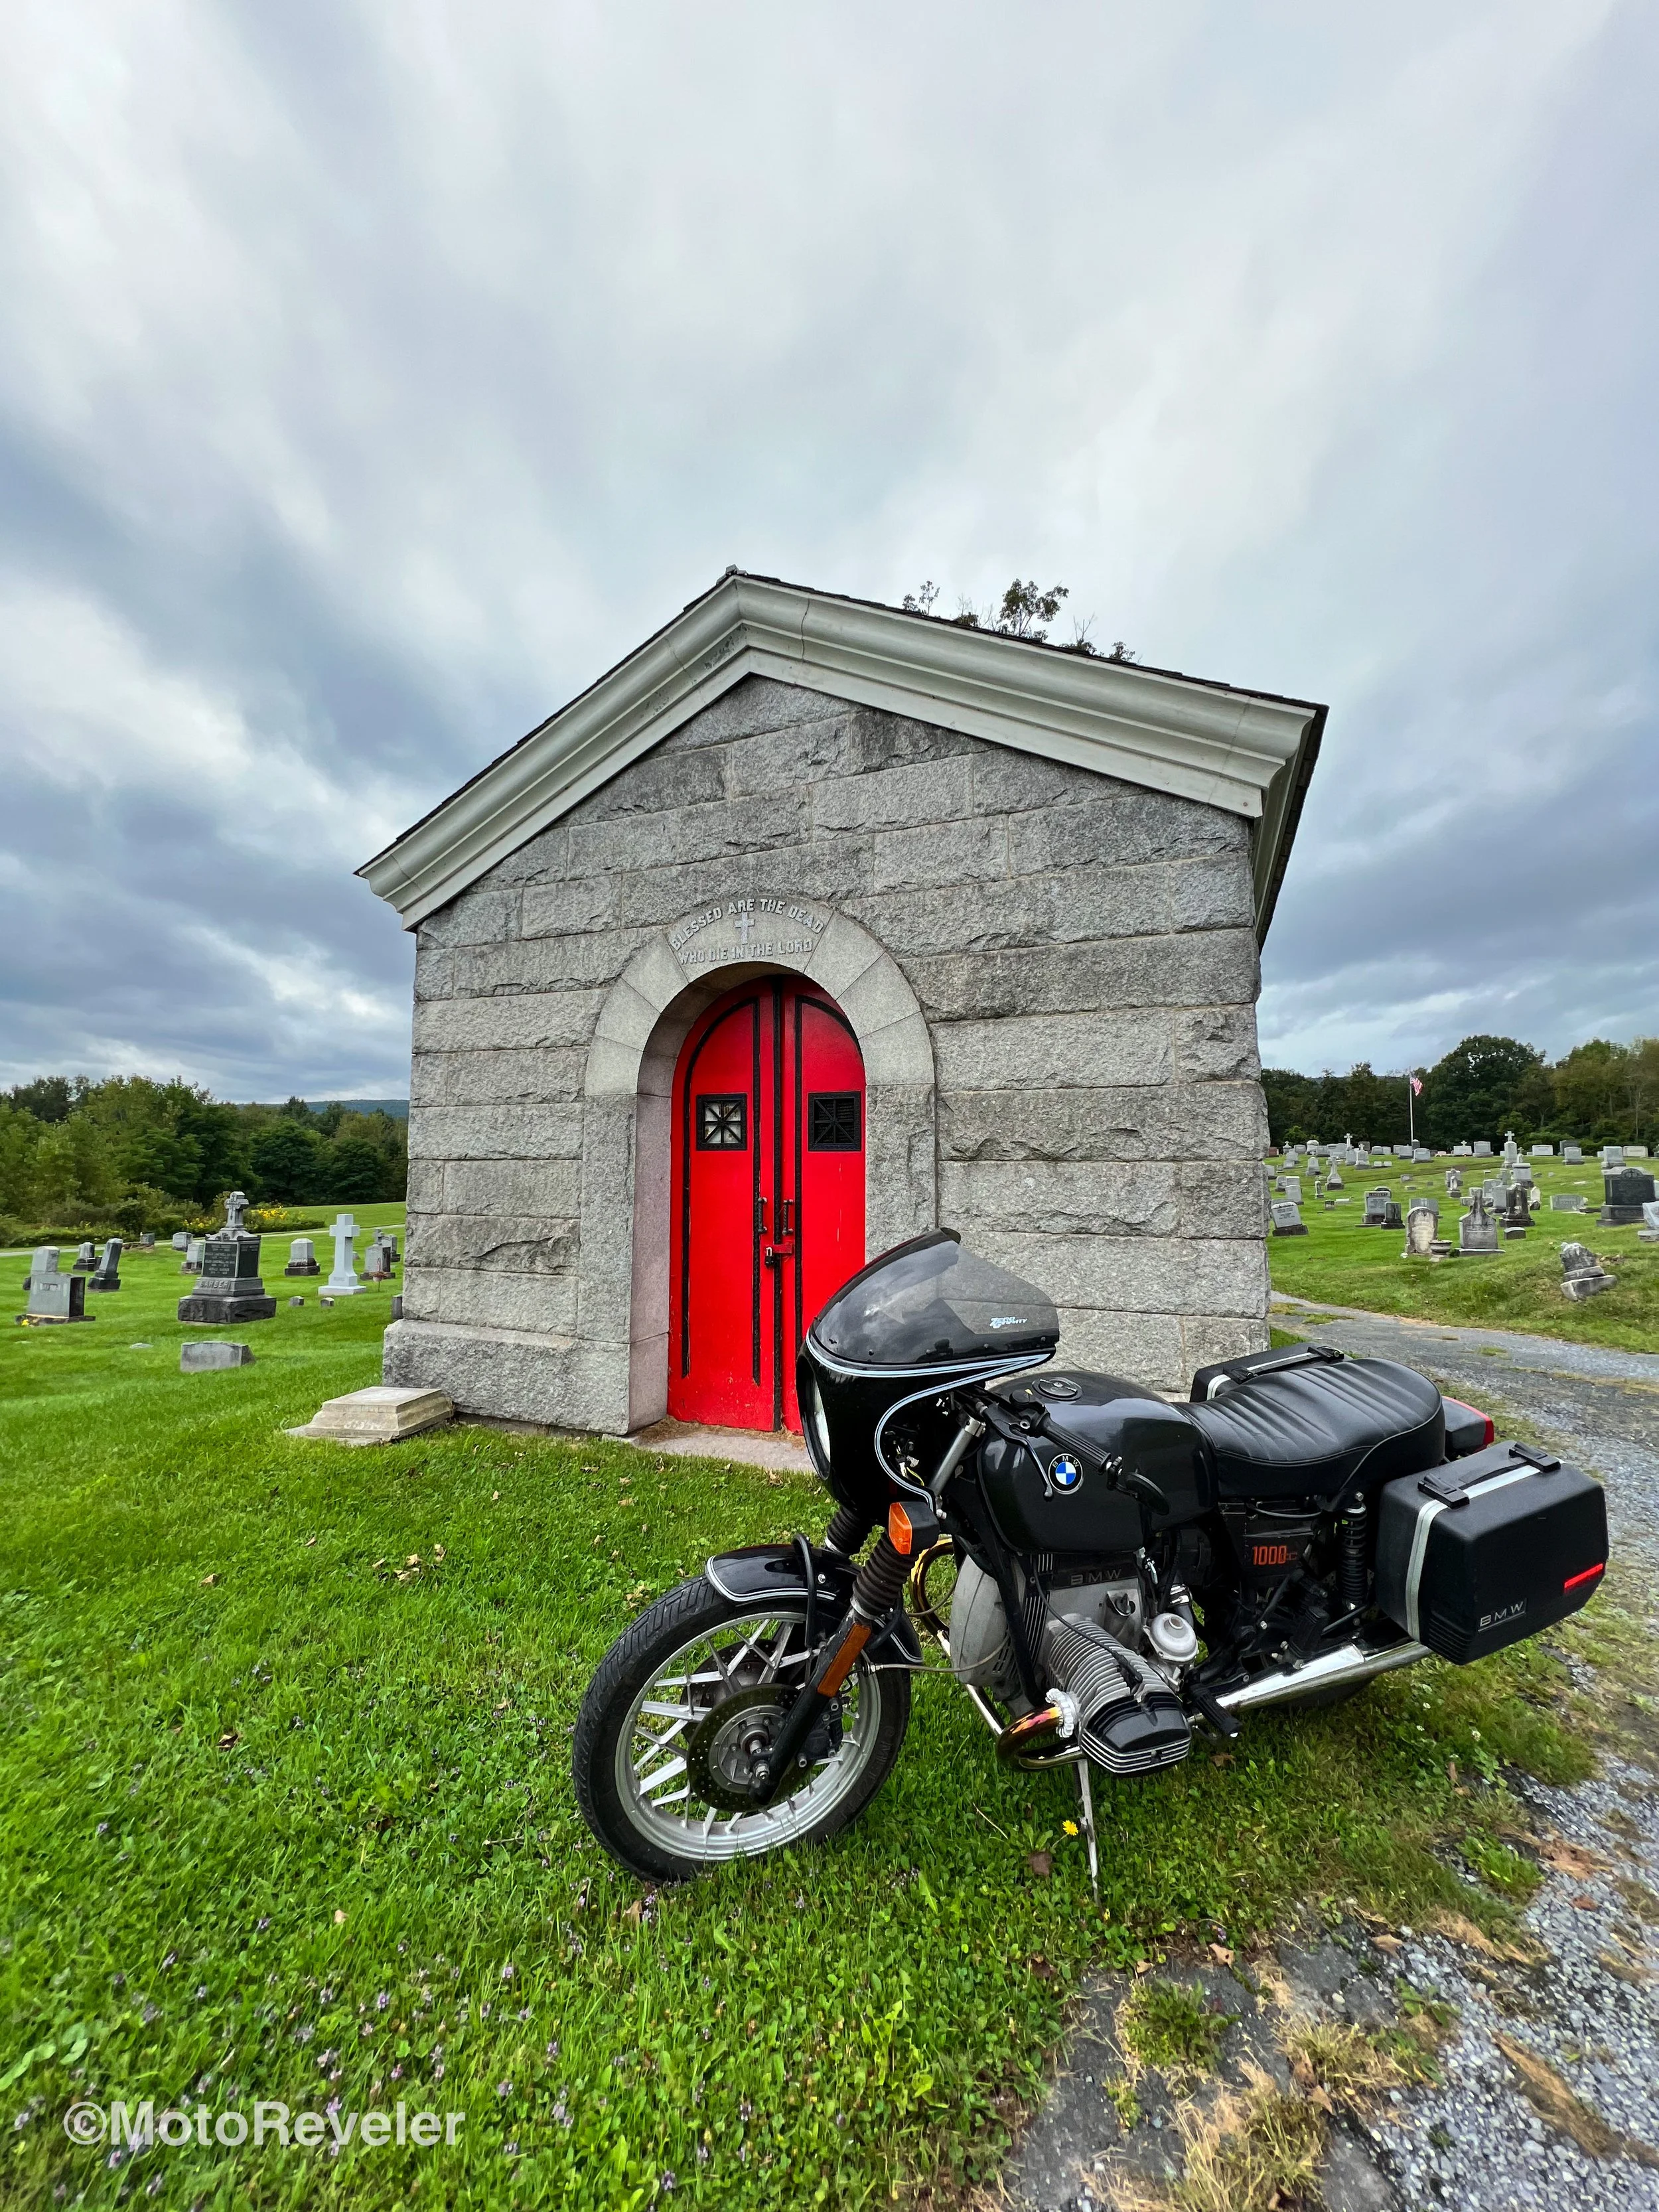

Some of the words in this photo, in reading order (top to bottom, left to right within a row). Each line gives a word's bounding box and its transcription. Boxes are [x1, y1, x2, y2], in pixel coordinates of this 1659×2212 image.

[670, 907, 723, 950] BLESSED
[728, 899, 755, 915] ARE
[760, 899, 786, 914] THE
[787, 905, 824, 934] DEAD
[678, 951, 705, 965] WHO
[709, 948, 728, 962] DIE
[732, 946, 745, 959] IN
[750, 944, 774, 958] THE
[778, 938, 813, 954] LORD
[1052, 1455, 1080, 1468] BMW
[1070, 1569, 1122, 1585] BMW
[1480, 1601, 1524, 1627] BMW
